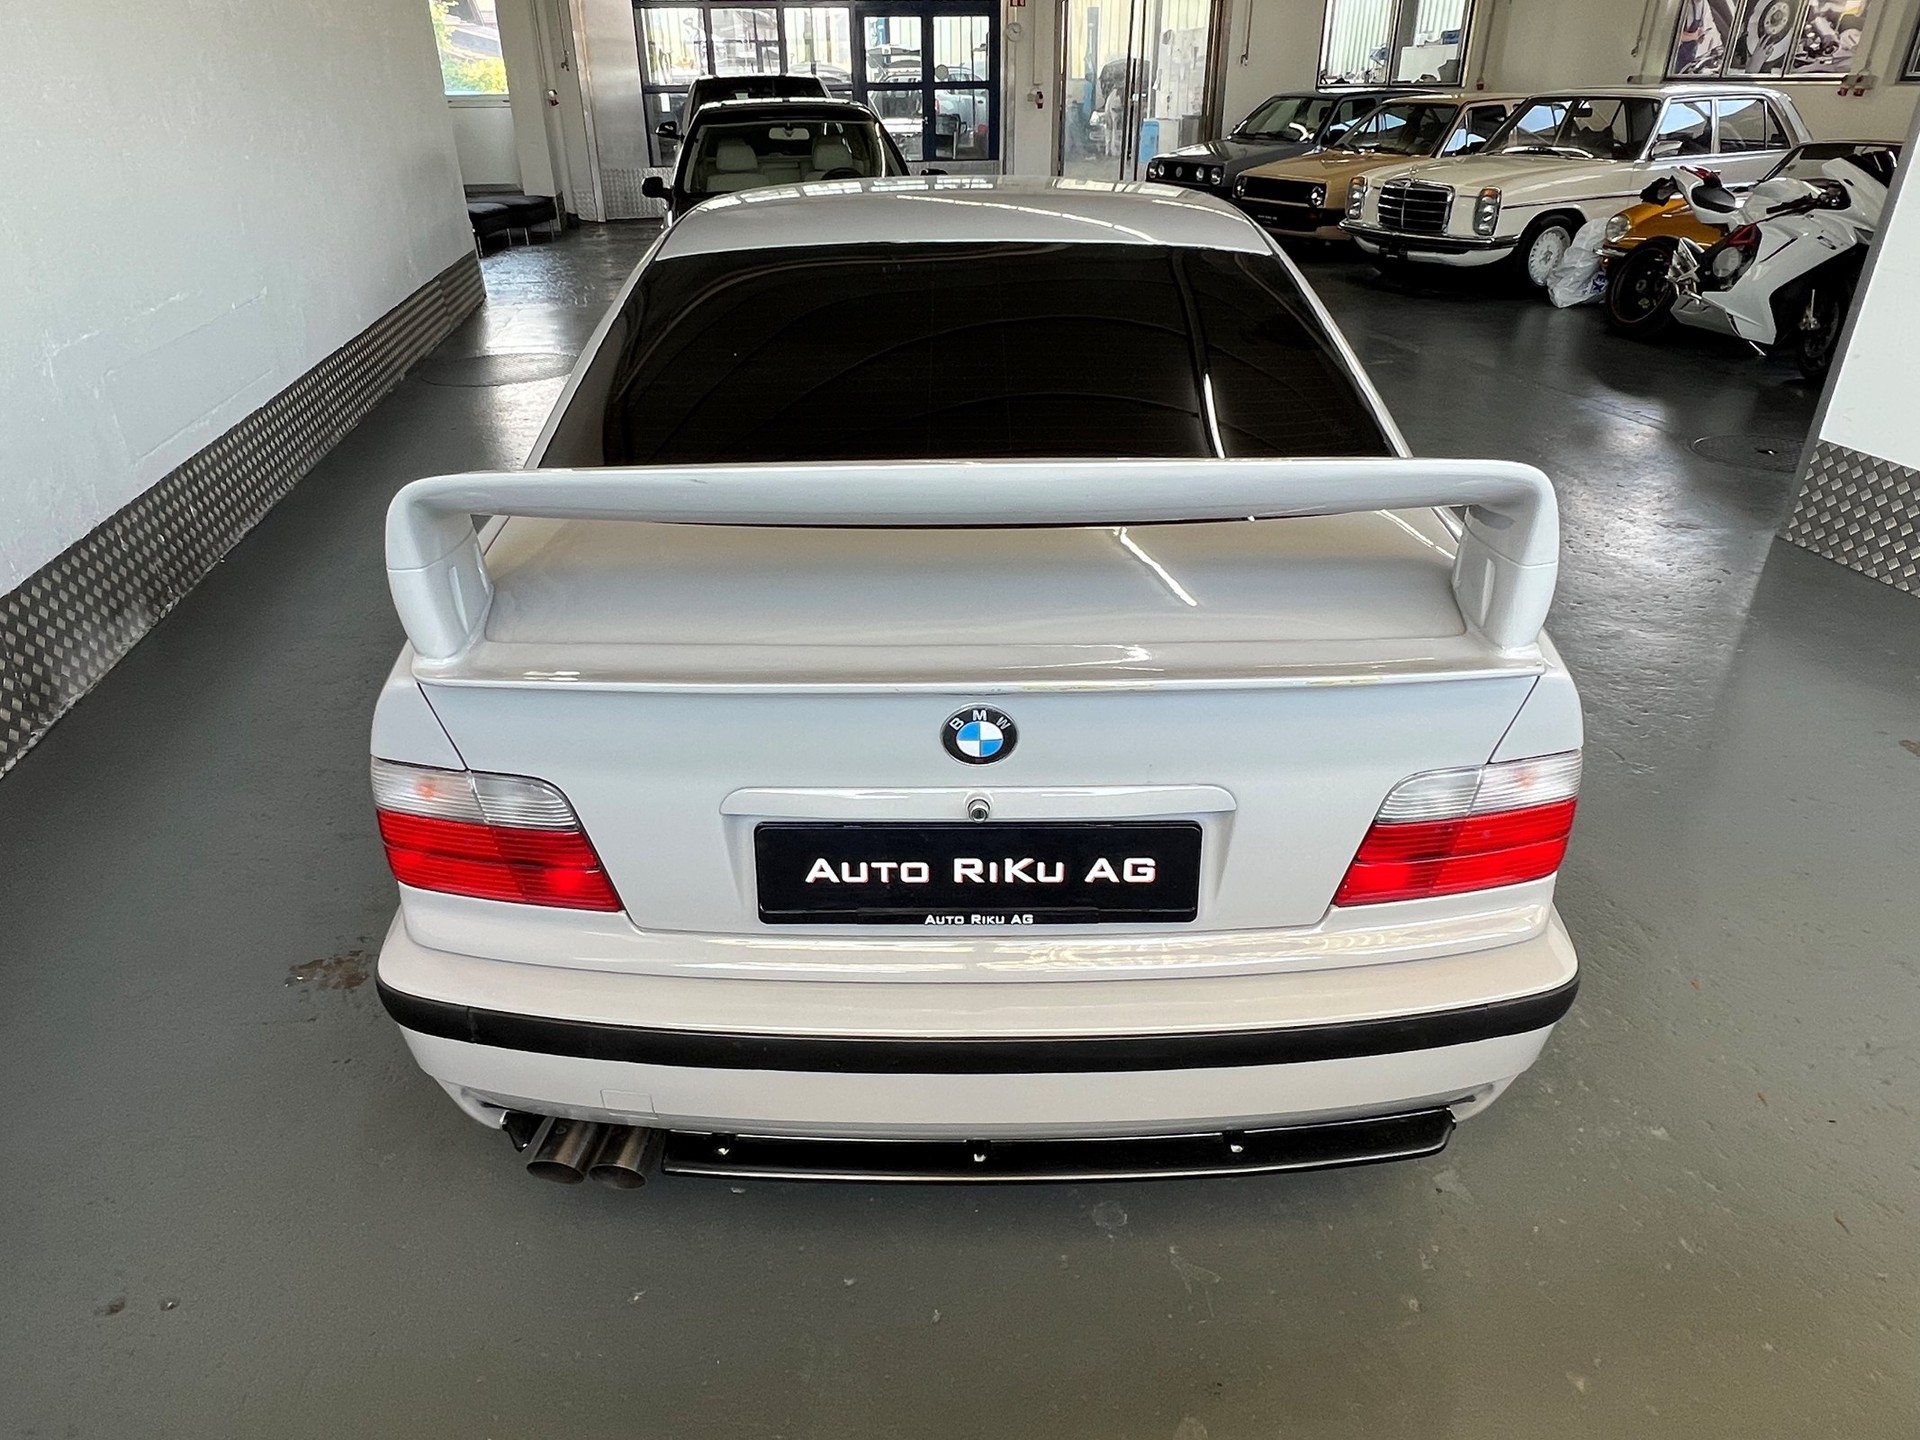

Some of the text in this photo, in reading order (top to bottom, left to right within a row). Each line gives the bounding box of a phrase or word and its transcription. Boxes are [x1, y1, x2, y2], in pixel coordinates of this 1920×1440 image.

[949, 709, 1011, 731] BMW
[1084, 857, 1158, 885] AG
[1010, 913, 1035, 925] AG
